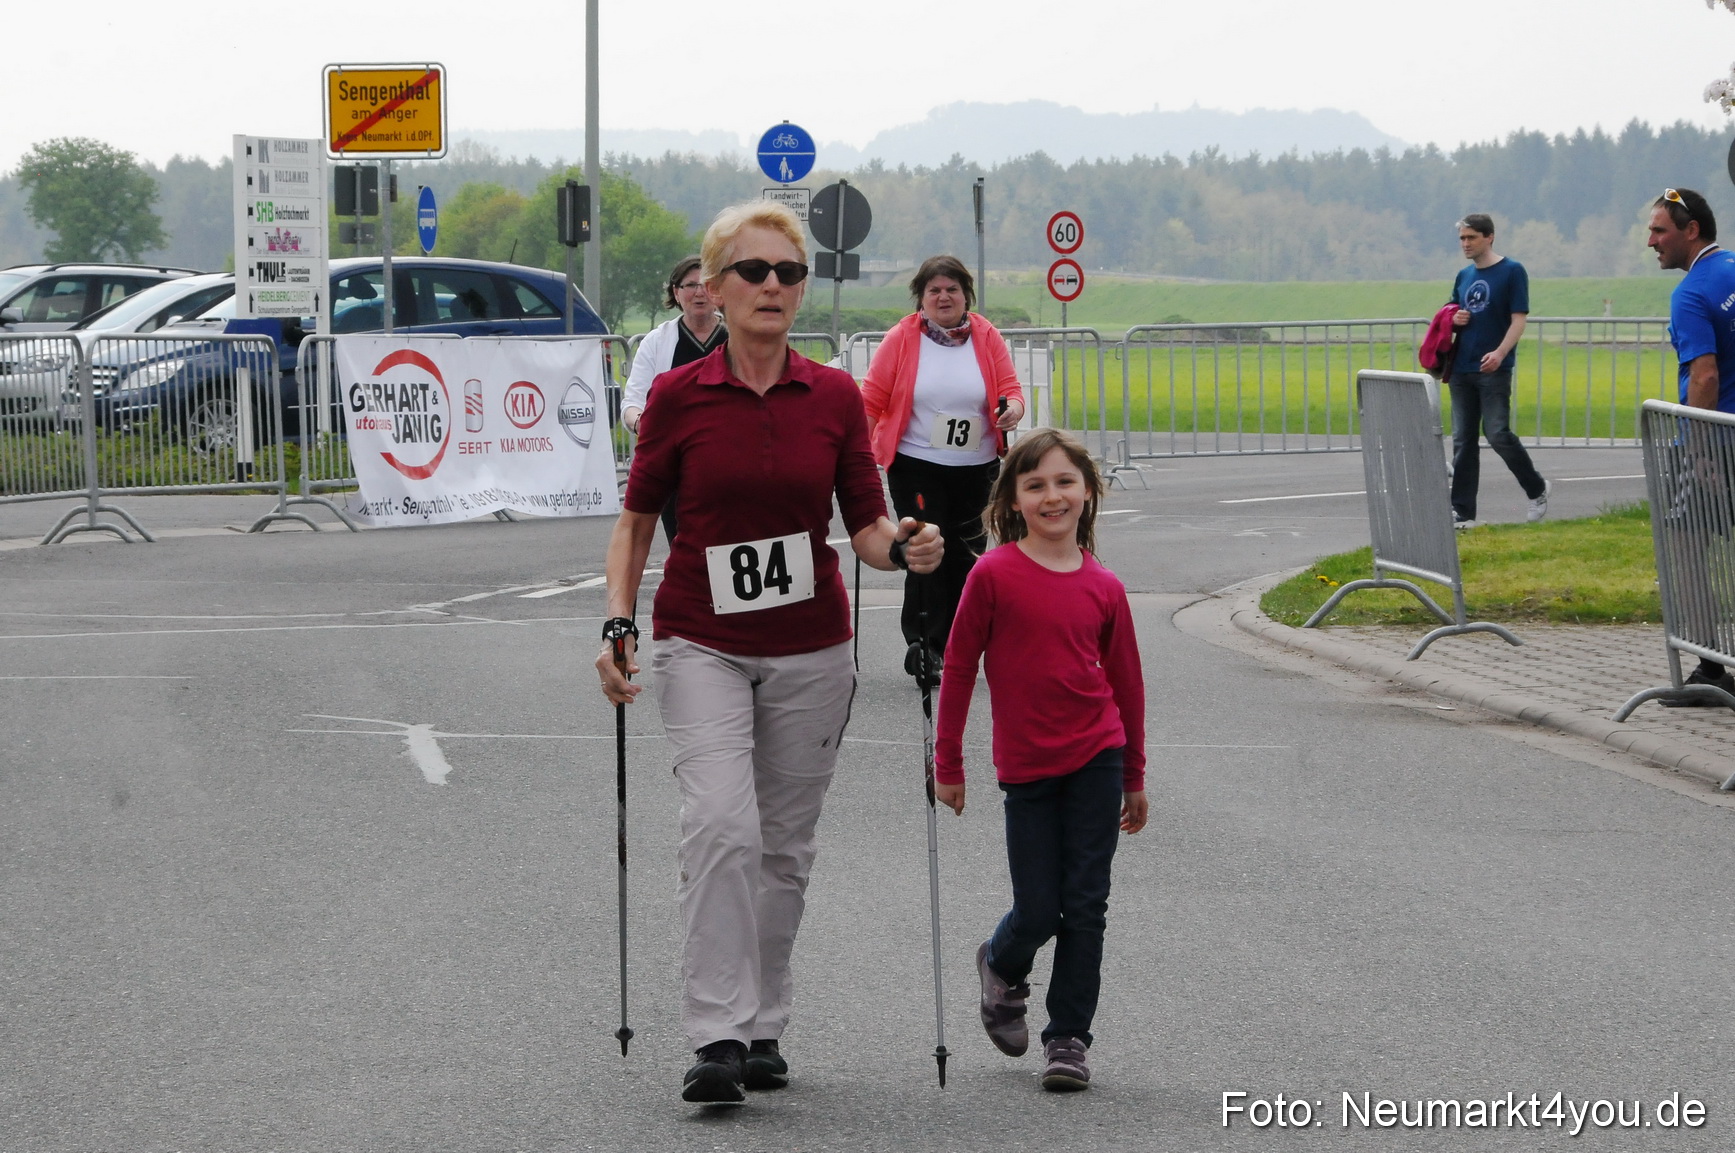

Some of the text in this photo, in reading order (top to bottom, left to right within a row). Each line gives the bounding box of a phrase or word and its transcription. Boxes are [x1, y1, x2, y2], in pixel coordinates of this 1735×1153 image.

[339, 80, 430, 106] Sengenthal
[351, 107, 418, 122] am Anger
[361, 131, 402, 142] Neumarkt
[274, 140, 308, 153] HOLZAMMER
[274, 170, 309, 183] HOLZAMMER
[770, 192, 803, 200] Landwirt-
[256, 201, 309, 223] SHB Holzfachmarkt
[1055, 223, 1076, 242] 60
[256, 262, 286, 282] THULE
[349, 382, 439, 412] GERHART &
[510, 393, 537, 417] KIA
[392, 414, 442, 444] JÄNIG
[946, 418, 971, 447] 13
[458, 441, 492, 454] SEAT
[500, 437, 554, 453] KIA MOTORS
[730, 540, 793, 601] 84
